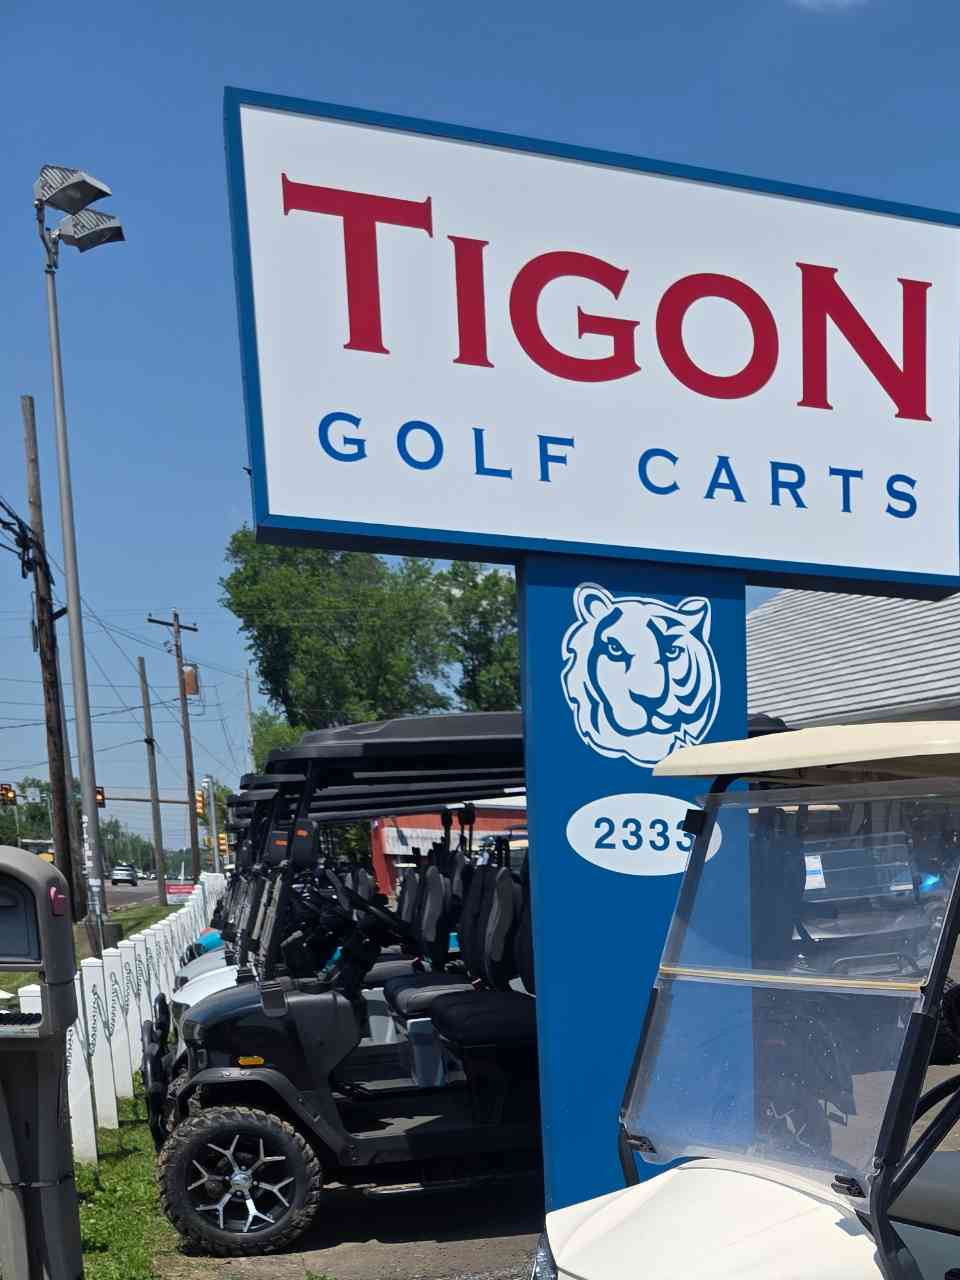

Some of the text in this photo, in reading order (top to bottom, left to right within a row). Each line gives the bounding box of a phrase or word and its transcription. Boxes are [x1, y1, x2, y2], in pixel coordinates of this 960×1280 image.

[281, 173, 932, 422] TIGON
[318, 411, 918, 519] GOLF CARTS
